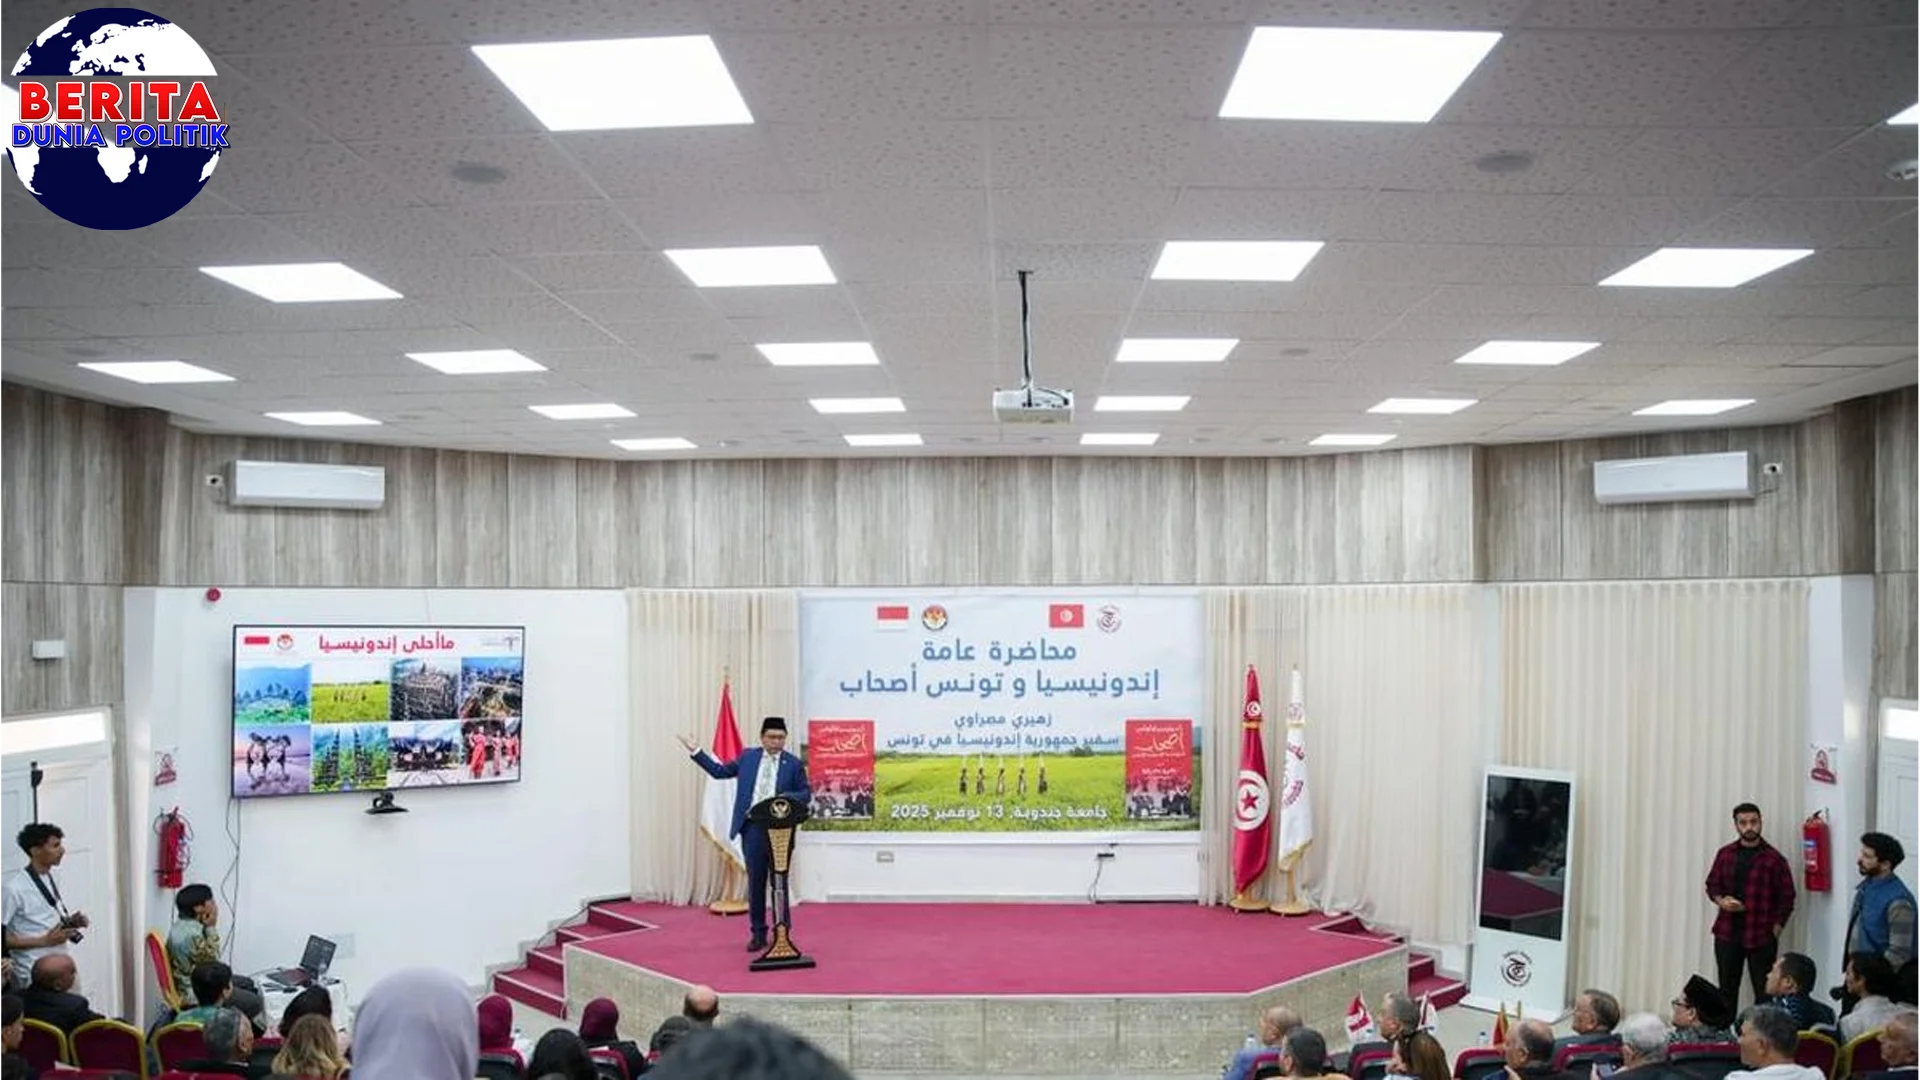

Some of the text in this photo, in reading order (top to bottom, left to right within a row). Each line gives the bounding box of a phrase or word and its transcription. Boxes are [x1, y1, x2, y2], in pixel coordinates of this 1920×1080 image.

[318, 634, 398, 655] إندونيسيا
[922, 637, 1077, 666] محاضرة عامة
[839, 662, 1160, 700] إندونيسيا و تونس أصحاب
[954, 711, 1053, 731] زهيري مصراوي
[887, 731, 1120, 750] سفير جمهورية إندونيسيا في تونس
[890, 804, 931, 818] 2025
[933, 806, 981, 821] نوفمبر
[987, 804, 1004, 818] 13
[1066, 803, 1108, 820] جامعة
